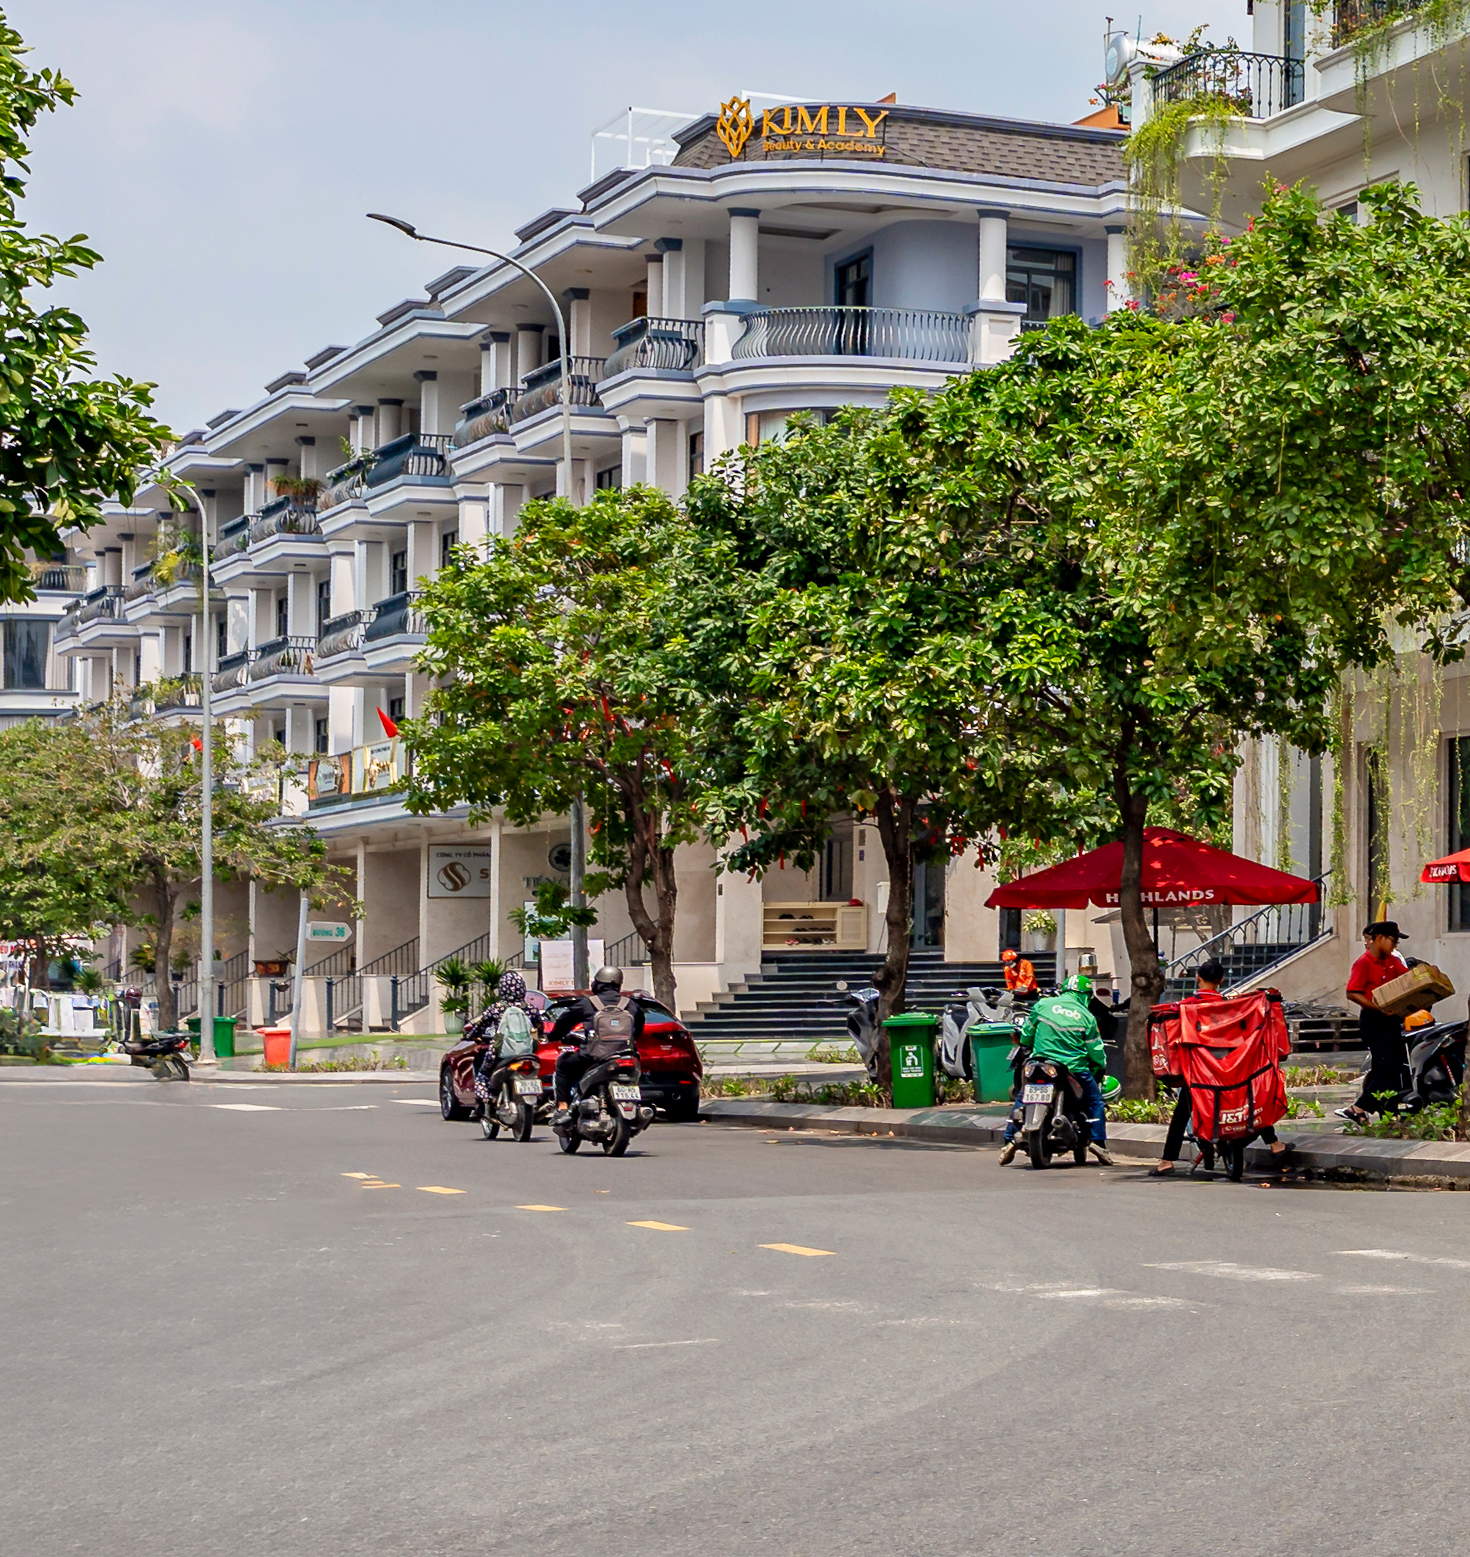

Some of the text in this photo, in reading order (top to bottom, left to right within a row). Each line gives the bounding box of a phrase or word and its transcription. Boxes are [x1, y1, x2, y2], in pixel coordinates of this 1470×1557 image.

[761, 106, 889, 138] KIMLY
[762, 138, 886, 155] Beauty & Academy
[1105, 889, 1214, 903] HHLANDS
[335, 926, 345, 937] 36
[1052, 1004, 1081, 1021] Grab
[1219, 1111, 1243, 1124] J&T
